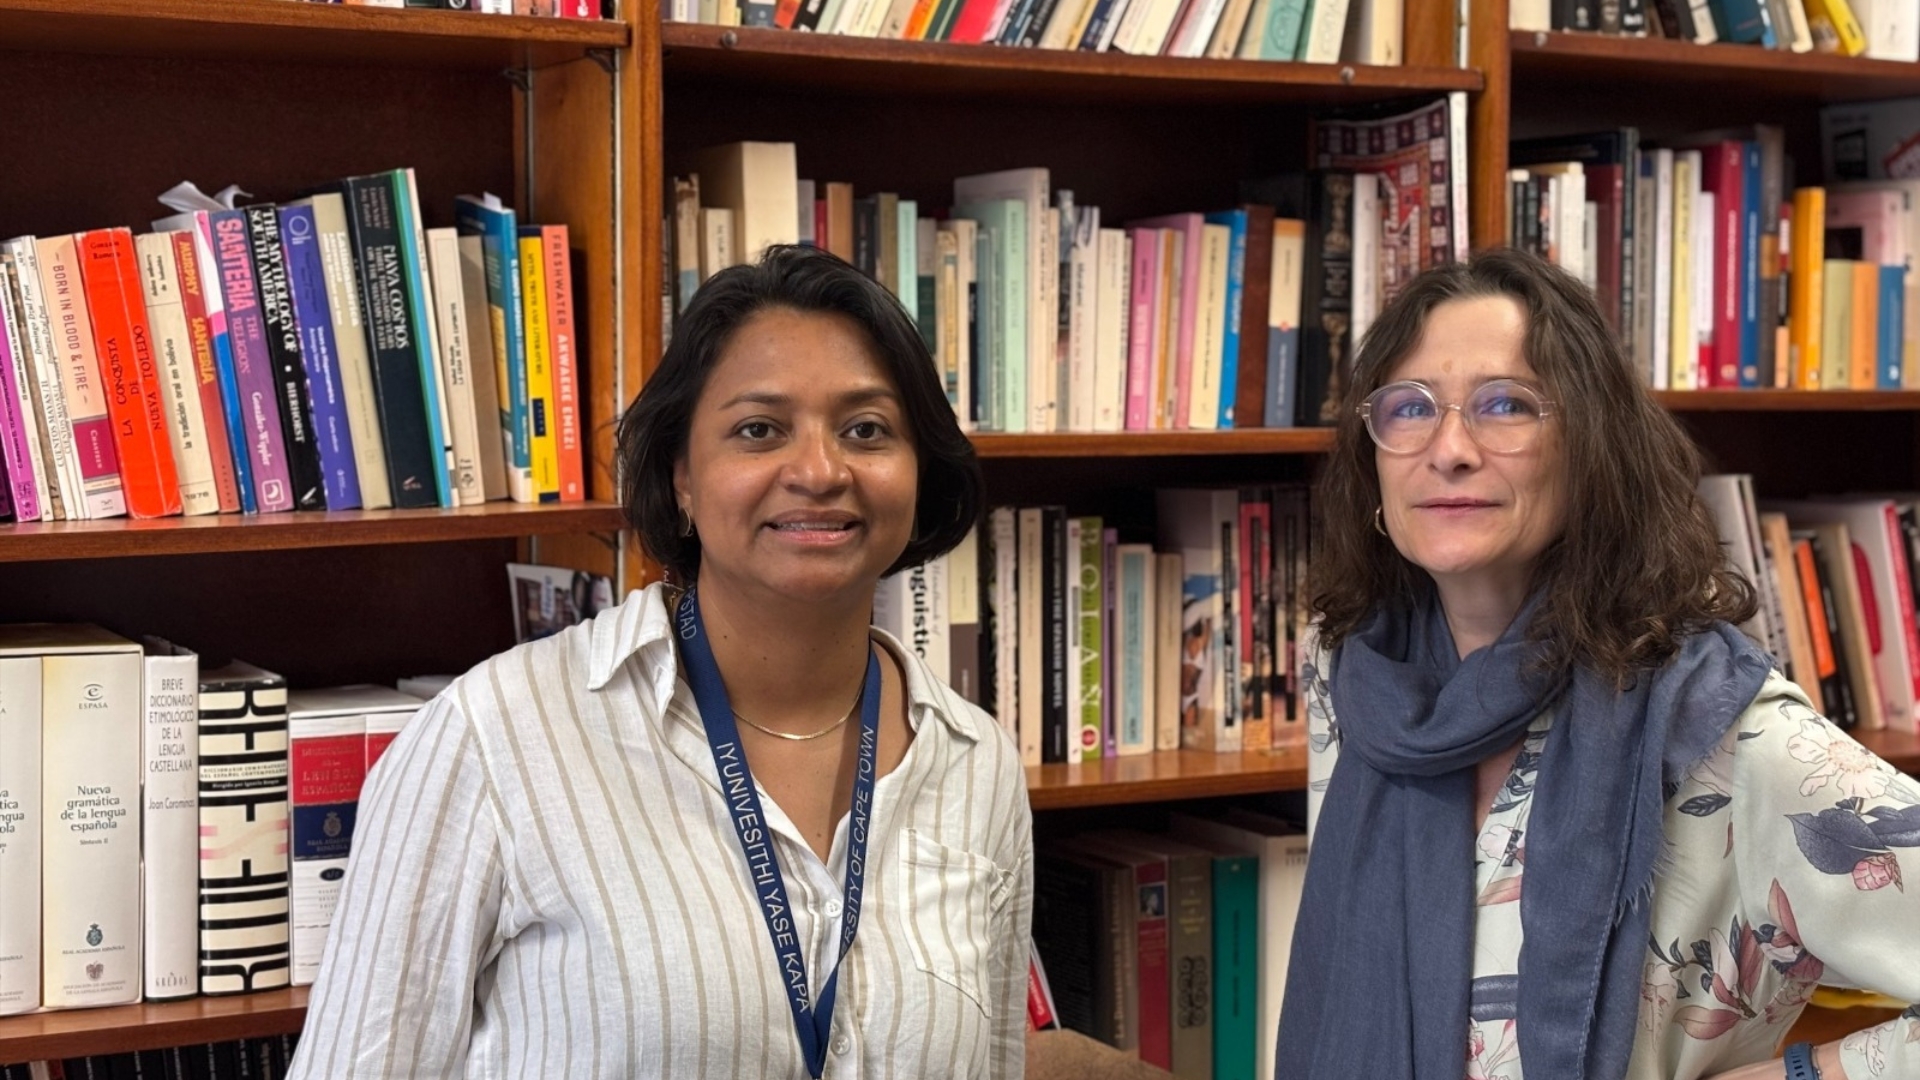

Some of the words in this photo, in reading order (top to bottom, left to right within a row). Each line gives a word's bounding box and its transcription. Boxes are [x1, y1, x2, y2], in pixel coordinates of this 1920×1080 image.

[250, 210, 268, 259] SOUTH
[263, 208, 278, 240] THE
[53, 264, 70, 295] BORN
[180, 241, 199, 296] MURPHY
[384, 245, 400, 287] MAYA
[552, 234, 566, 325] FRESHWATER
[258, 262, 279, 325] AMERICA
[269, 242, 294, 331] MYTHOLOGY
[60, 299, 72, 311] IN
[390, 290, 409, 349] COSMOS
[32, 322, 42, 355] Domingo
[63, 314, 80, 350] BLOOD
[246, 315, 259, 340] THE
[133, 325, 153, 380] TOLEDO
[166, 338, 176, 367] bolivia
[232, 317, 250, 373] RELIGION
[284, 333, 298, 352] OF
[71, 354, 82, 362] &
[107, 338, 127, 405] CONQUISTA
[557, 334, 572, 402] AKWAEKE
[72, 366, 89, 391] FIRE
[129, 381, 139, 395] DE
[171, 369, 180, 380] en
[172, 383, 182, 399] oral
[45, 394, 56, 424] MAYAS
[148, 392, 162, 431] NUEVA
[178, 402, 190, 439] tradición
[122, 420, 133, 437] LA
[562, 406, 575, 450] EMEZI
[50, 425, 64, 468] CUENTOS
[184, 441, 192, 450] la
[680, 589, 696, 640] PSTAD
[910, 560, 929, 659] nguistic
[162, 678, 184, 690] BREVE
[78, 702, 108, 710] ESPASA
[150, 694, 194, 707] DICCIONARIO
[149, 708, 194, 724] ETIMOLÓGICO
[162, 727, 172, 740] DE
[174, 727, 182, 738] LA
[158, 744, 186, 756] LENGUA
[858, 724, 874, 783] TOWN
[150, 760, 192, 772] CASTELLANA
[66, 796, 120, 810] gramática
[78, 786, 111, 796] Nueva
[148, 799, 164, 810] Joan
[165, 797, 195, 809] Corominas
[0, 812, 24, 823] ngua
[60, 810, 74, 820] de
[78, 808, 87, 819] la
[90, 807, 126, 821] lengua
[70, 819, 118, 833] española
[854, 790, 869, 843] CAPE
[851, 848, 866, 875] OF
[716, 742, 776, 886] IYUNIVESITHI
[764, 888, 794, 948] YASE
[782, 952, 810, 1014] KAPA
